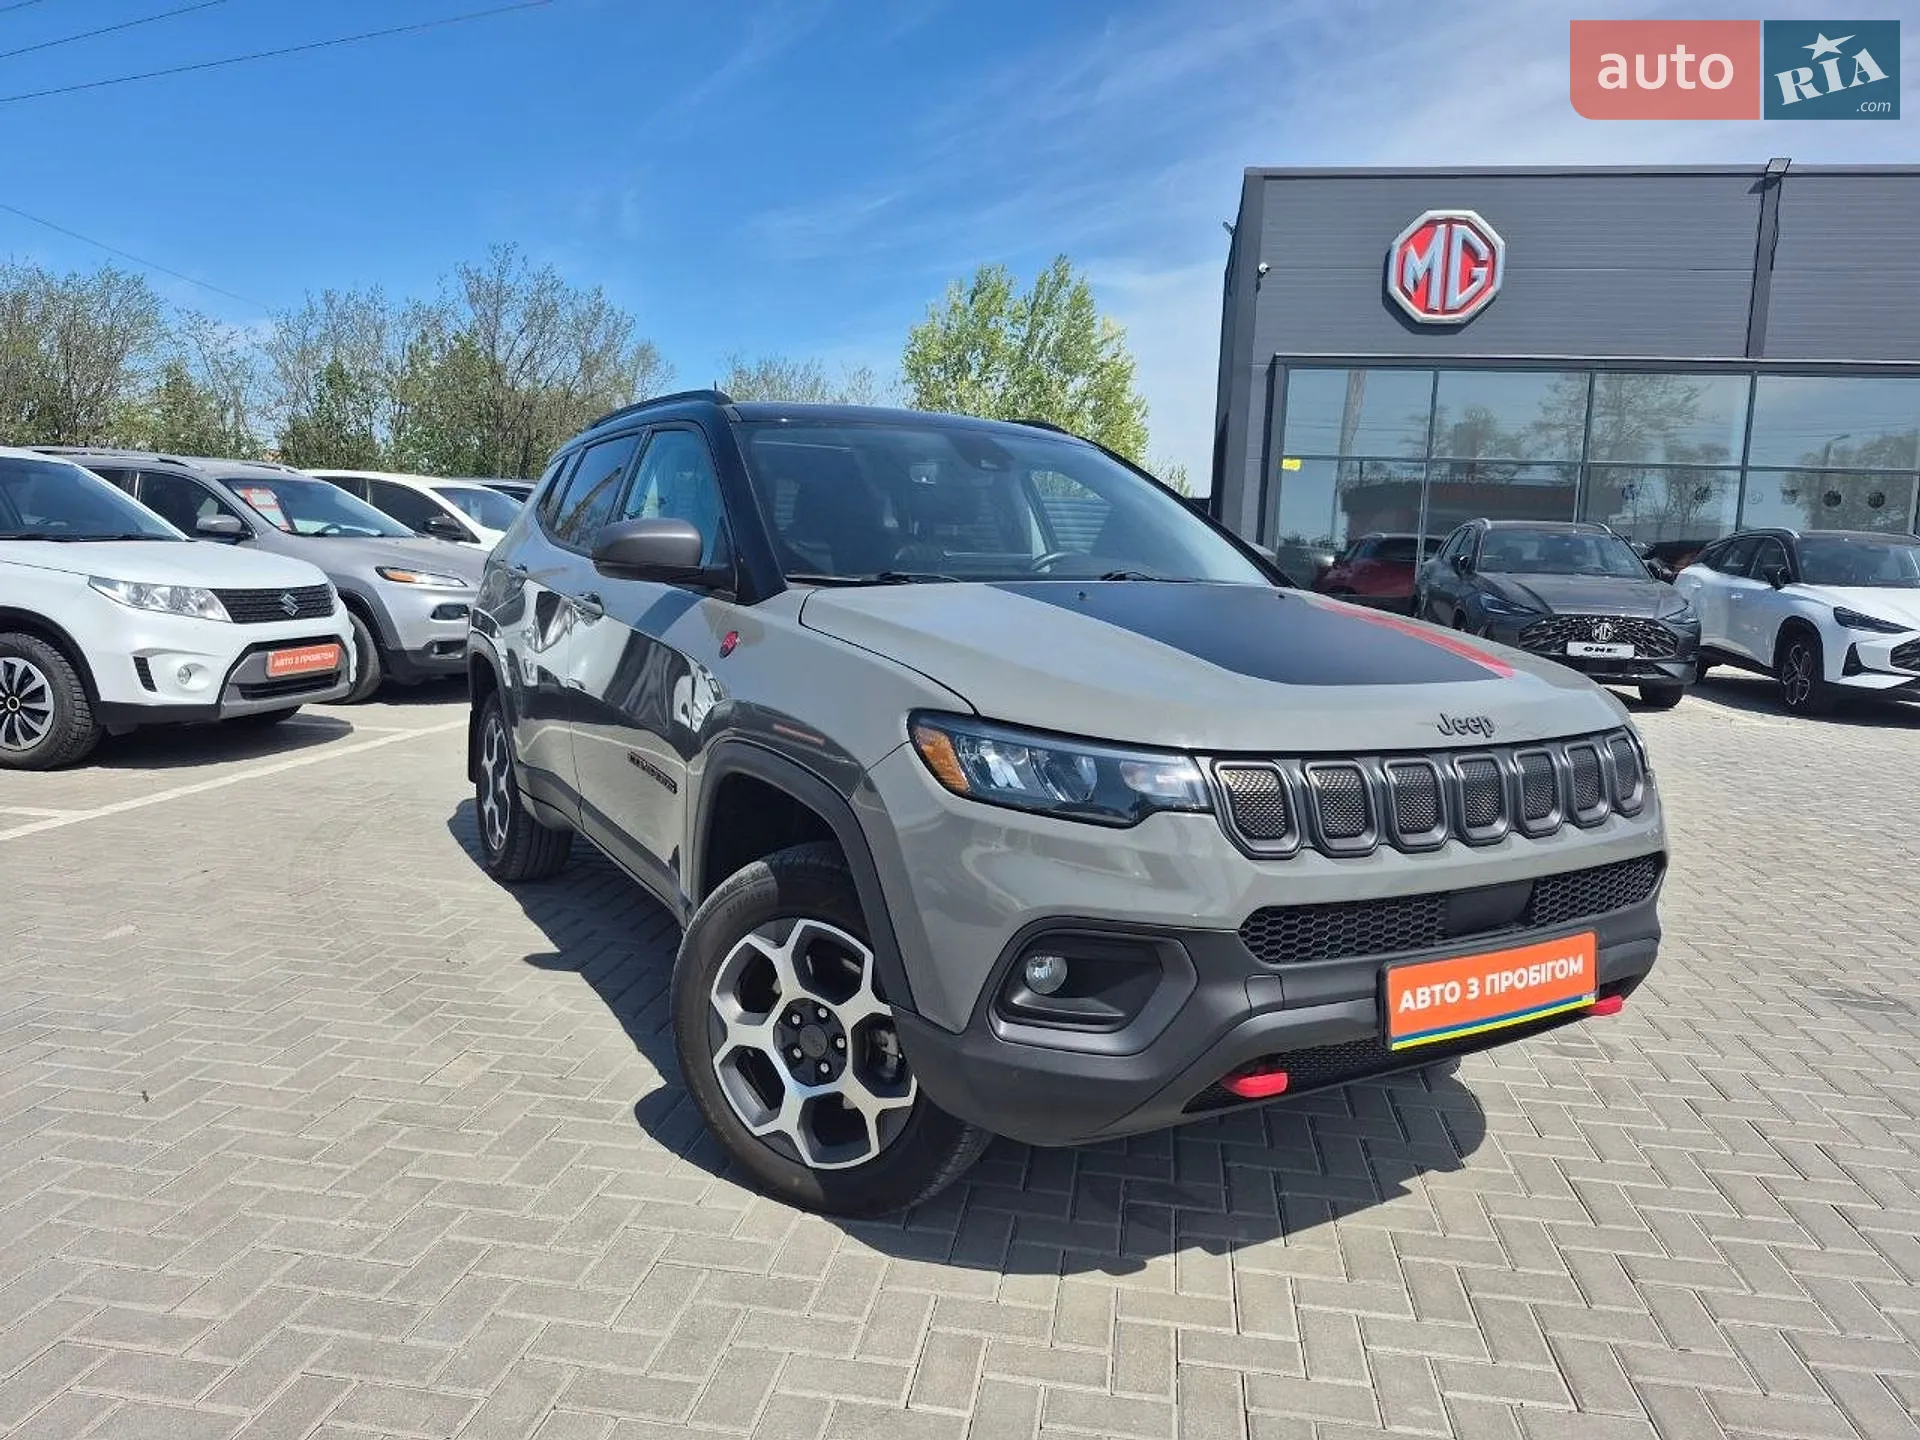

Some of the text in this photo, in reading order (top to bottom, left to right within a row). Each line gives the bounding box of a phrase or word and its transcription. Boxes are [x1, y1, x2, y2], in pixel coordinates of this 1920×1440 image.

[1403, 223, 1490, 310] MG
[1437, 712, 1495, 738] Jeep
[1398, 980, 1461, 1013] АВТО
[1485, 954, 1584, 995] ПРОБІГОМ
